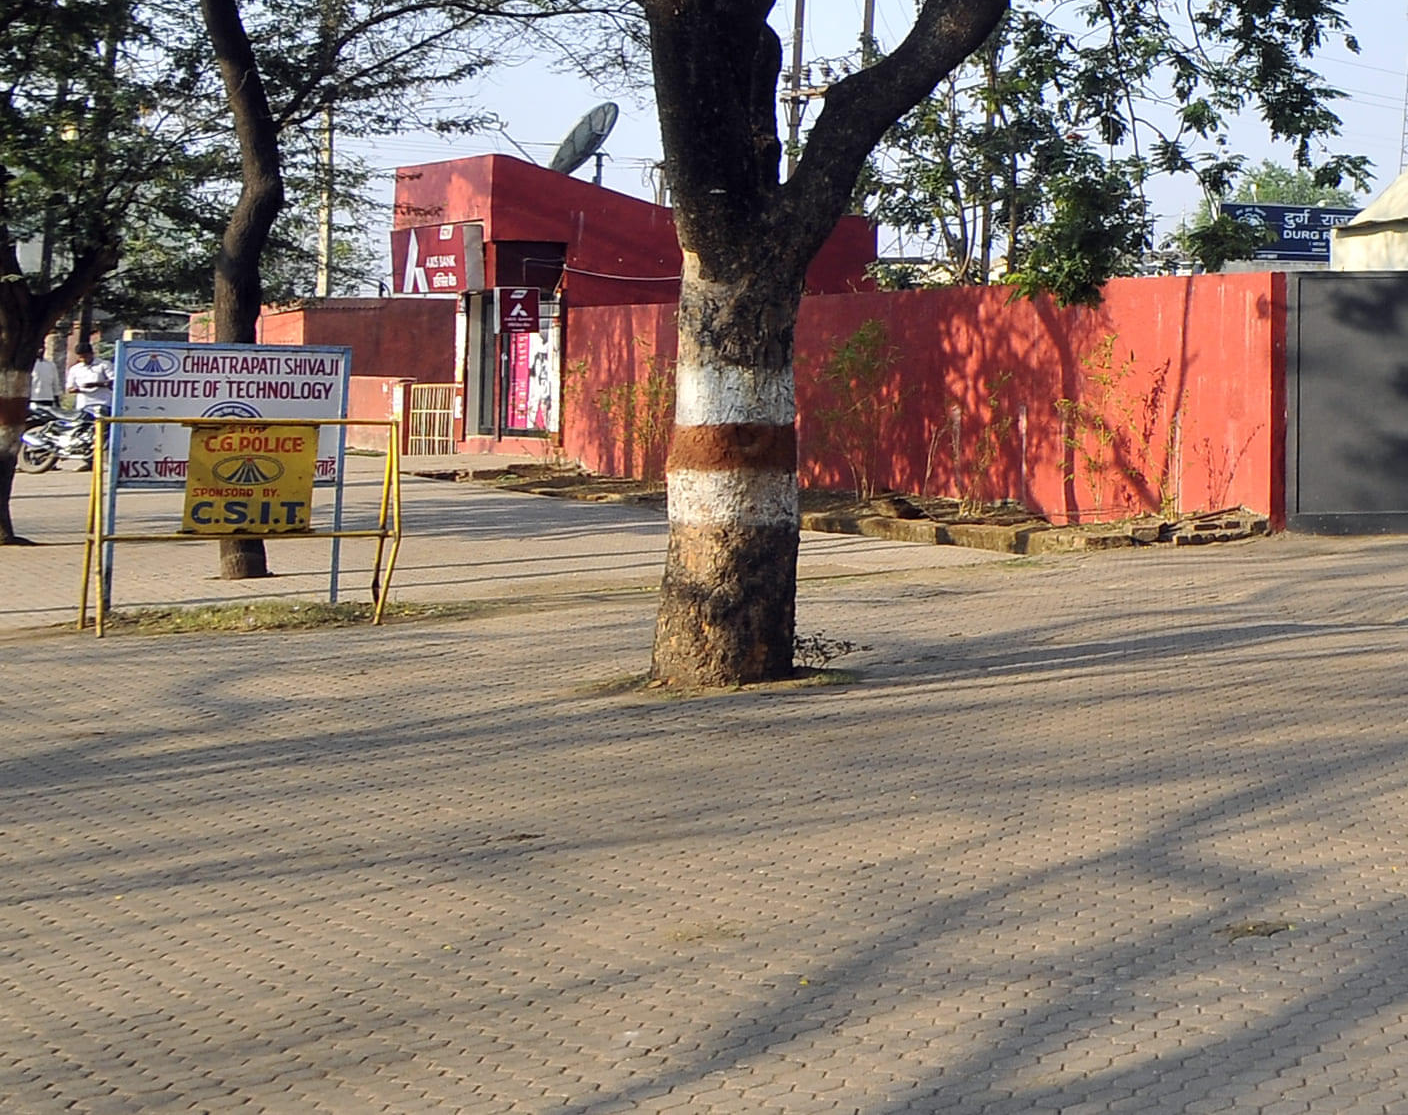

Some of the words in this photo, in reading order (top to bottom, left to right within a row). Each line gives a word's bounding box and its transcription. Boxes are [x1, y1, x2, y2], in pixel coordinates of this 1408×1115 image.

[1283, 230, 1320, 240] DURG
[182, 355, 280, 375] CHHATRAPATI
[284, 357, 339, 377] SHIVAJI
[125, 379, 199, 398] INSTITUTE
[202, 380, 221, 398] OF
[227, 380, 334, 400] TECHNOLOGY
[154, 456, 188, 478] परिवा
[191, 501, 305, 525] C.S.I.T.
